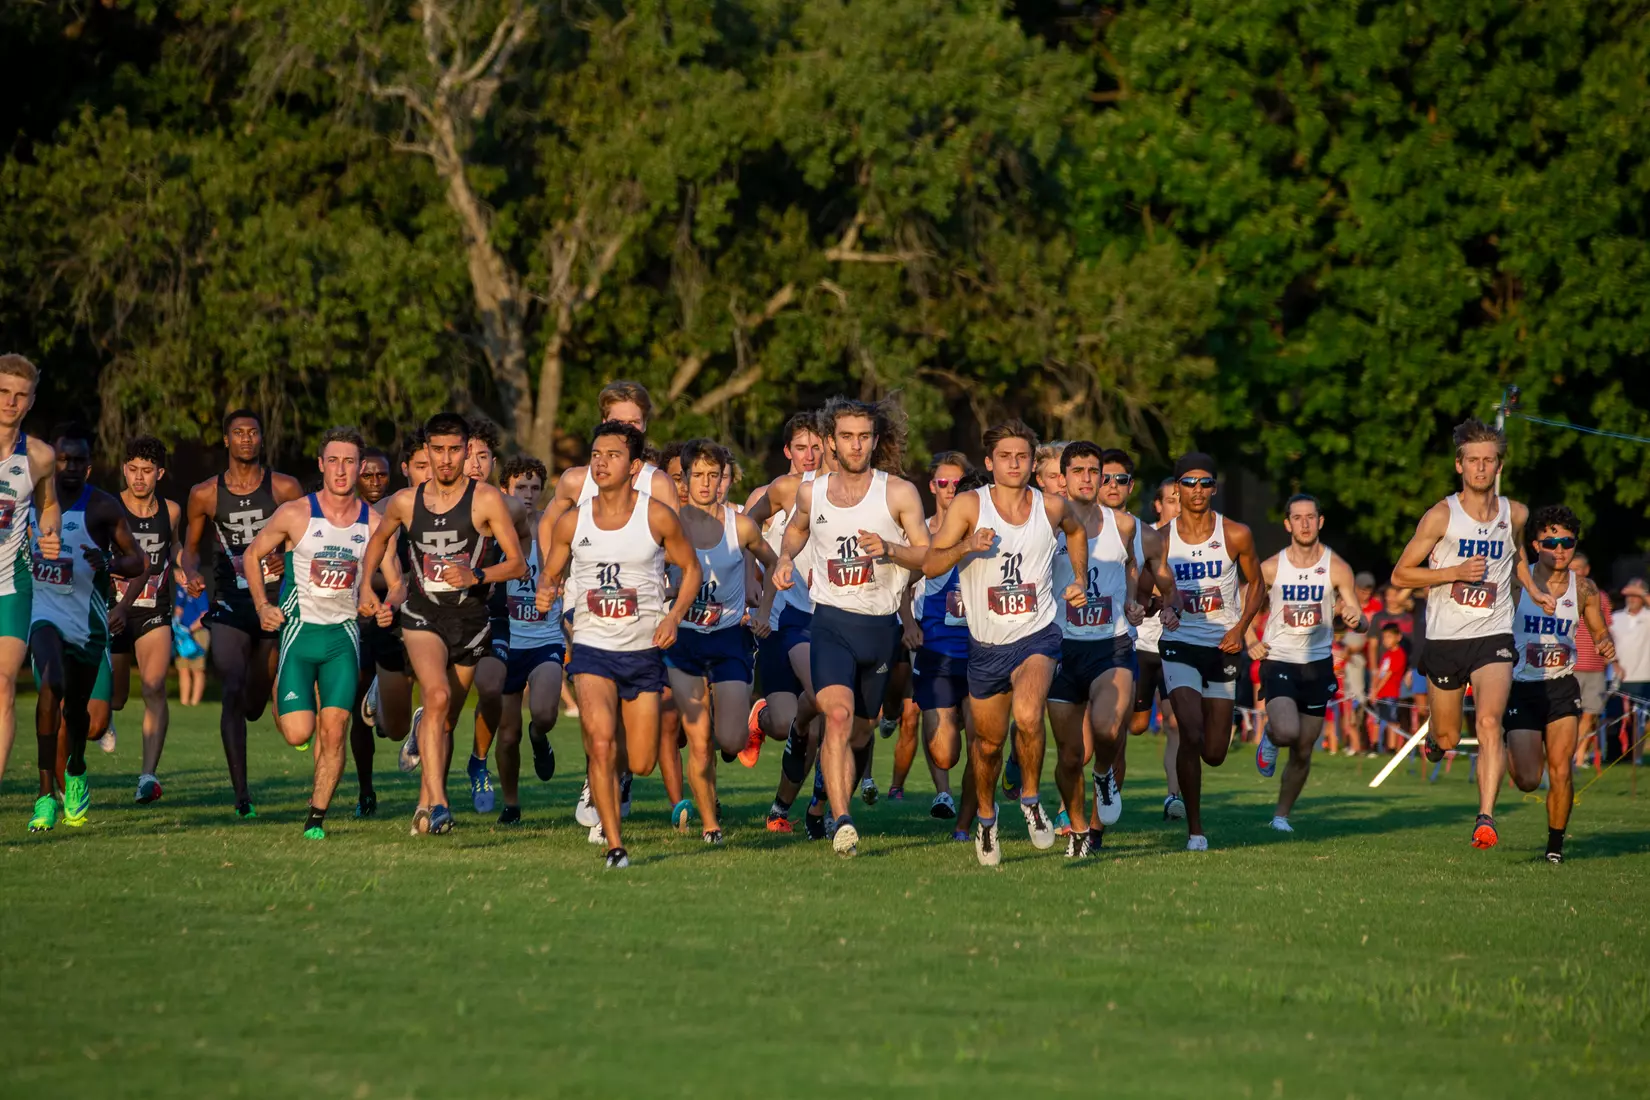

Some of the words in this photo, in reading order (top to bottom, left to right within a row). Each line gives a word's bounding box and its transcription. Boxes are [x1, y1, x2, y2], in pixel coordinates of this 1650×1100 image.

[1458, 538, 1504, 560] HBU
[37, 563, 62, 583] 223
[596, 562, 624, 589] R
[838, 566, 863, 585] 177
[1001, 552, 1023, 585] R
[1174, 560, 1222, 581] HBU
[320, 569, 347, 588] 222
[1281, 585, 1325, 601] HBU
[1462, 588, 1487, 606] 149
[516, 604, 539, 620] 185
[599, 599, 627, 616] 175
[999, 594, 1027, 614] 183
[1189, 596, 1213, 613] 147
[689, 607, 712, 625] 172
[1077, 606, 1103, 625] 167
[1292, 611, 1315, 627] 148
[1523, 615, 1573, 637] HBU
[1537, 651, 1561, 667] 145
